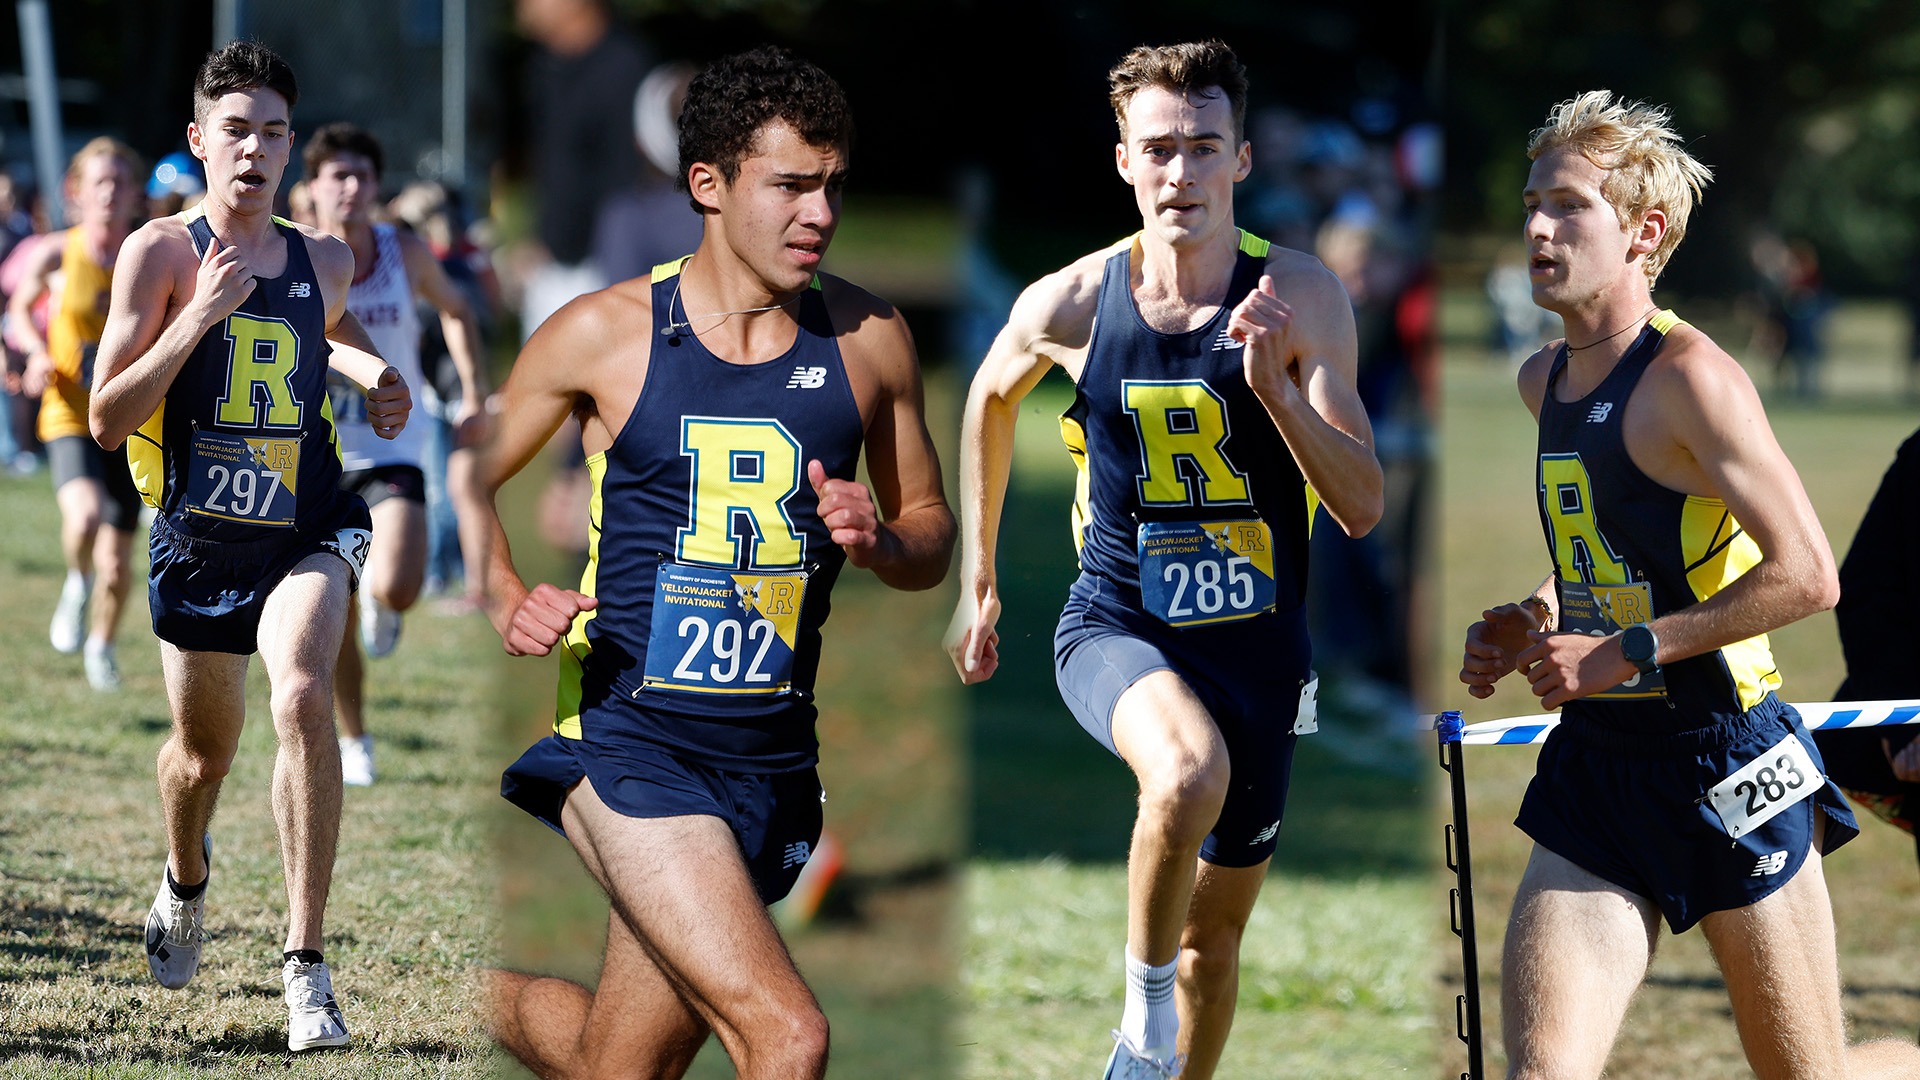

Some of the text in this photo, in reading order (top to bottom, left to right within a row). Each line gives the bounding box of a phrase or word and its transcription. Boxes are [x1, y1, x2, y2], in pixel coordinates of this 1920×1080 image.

[214, 310, 304, 430] R
[785, 366, 828, 389] NB
[194, 442, 246, 455] YELLOWJACKET
[197, 450, 241, 462] INVITATIONAL
[272, 443, 293, 469] R
[1121, 379, 1254, 507] R
[204, 465, 283, 517] 297
[674, 415, 807, 570] R
[1540, 452, 1632, 584] R
[351, 533, 371, 567] 29
[1142, 536, 1204, 547] YELLOWJACKET
[1147, 546, 1200, 557] INVITATIONAL
[1238, 525, 1265, 552] R
[660, 582, 733, 598] YELLOWJACKET
[664, 594, 727, 609] INVITATIONAL
[766, 581, 795, 615] R
[1163, 556, 1255, 618] 285
[1616, 592, 1645, 624] R
[672, 615, 776, 683] 292
[1734, 754, 1805, 818] 283
[1751, 850, 1789, 877] NB
